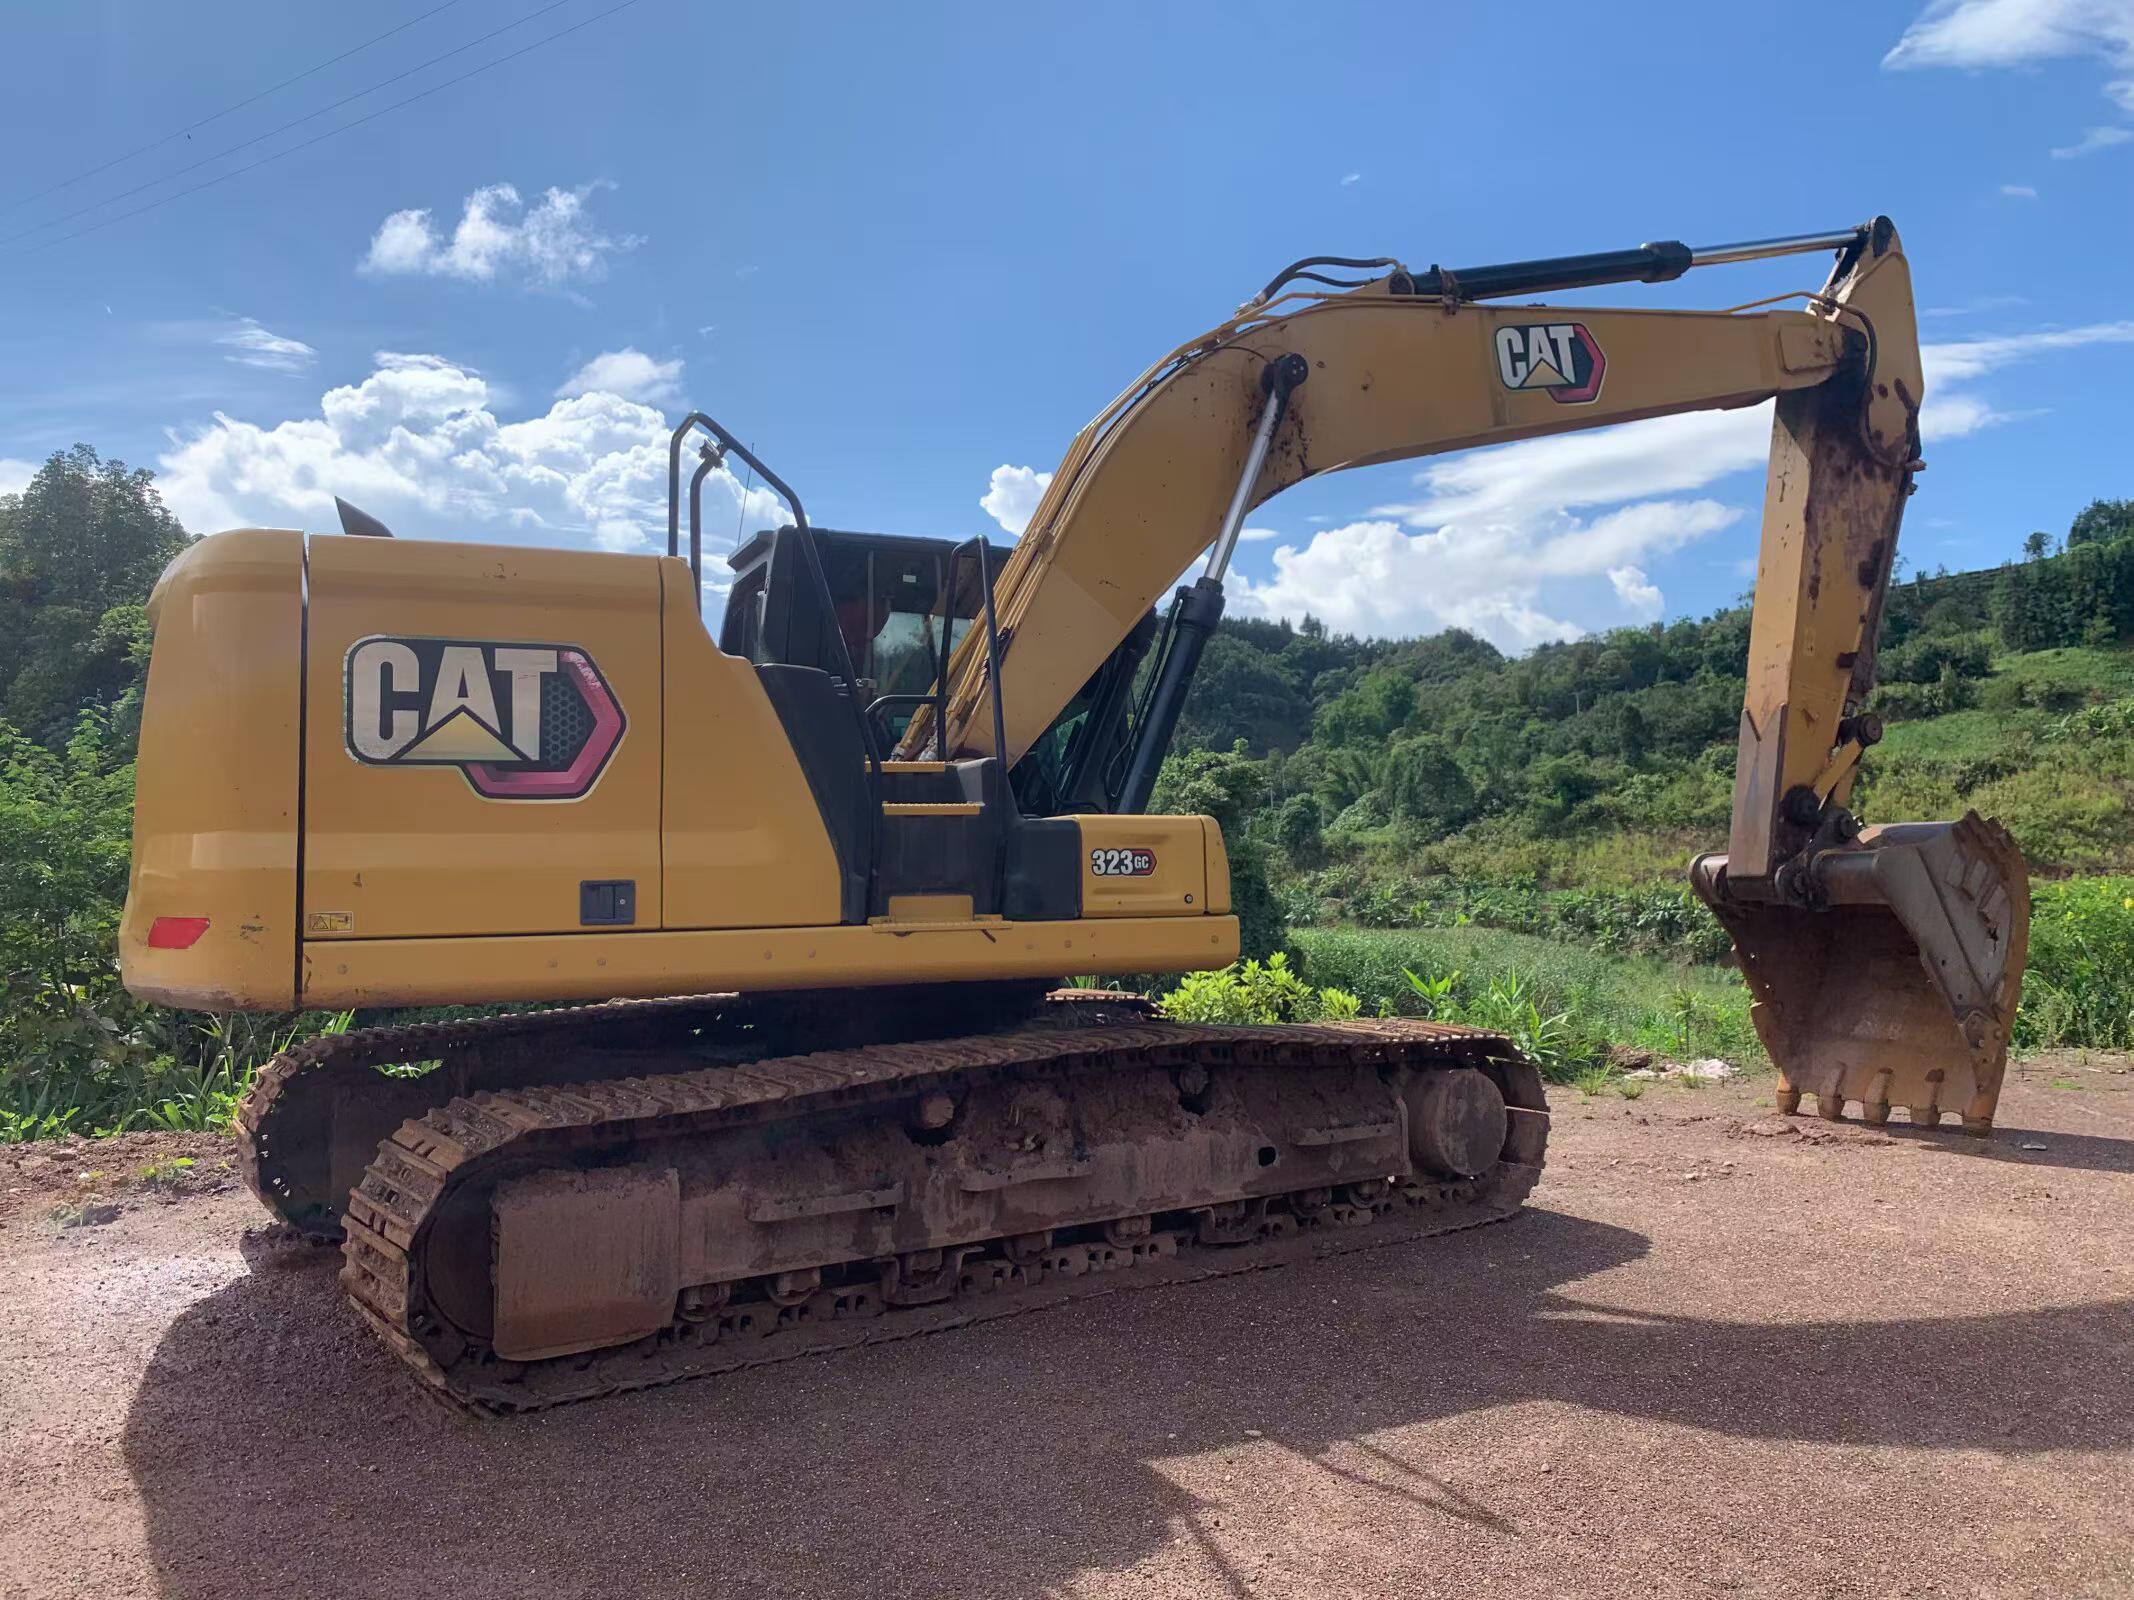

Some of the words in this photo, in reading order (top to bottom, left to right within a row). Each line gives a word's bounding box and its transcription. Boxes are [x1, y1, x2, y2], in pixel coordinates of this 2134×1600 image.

[1496, 325, 1575, 388] CAT
[352, 641, 558, 761] CAT
[1092, 849, 1133, 875] 323
[1134, 855, 1149, 869] GC
